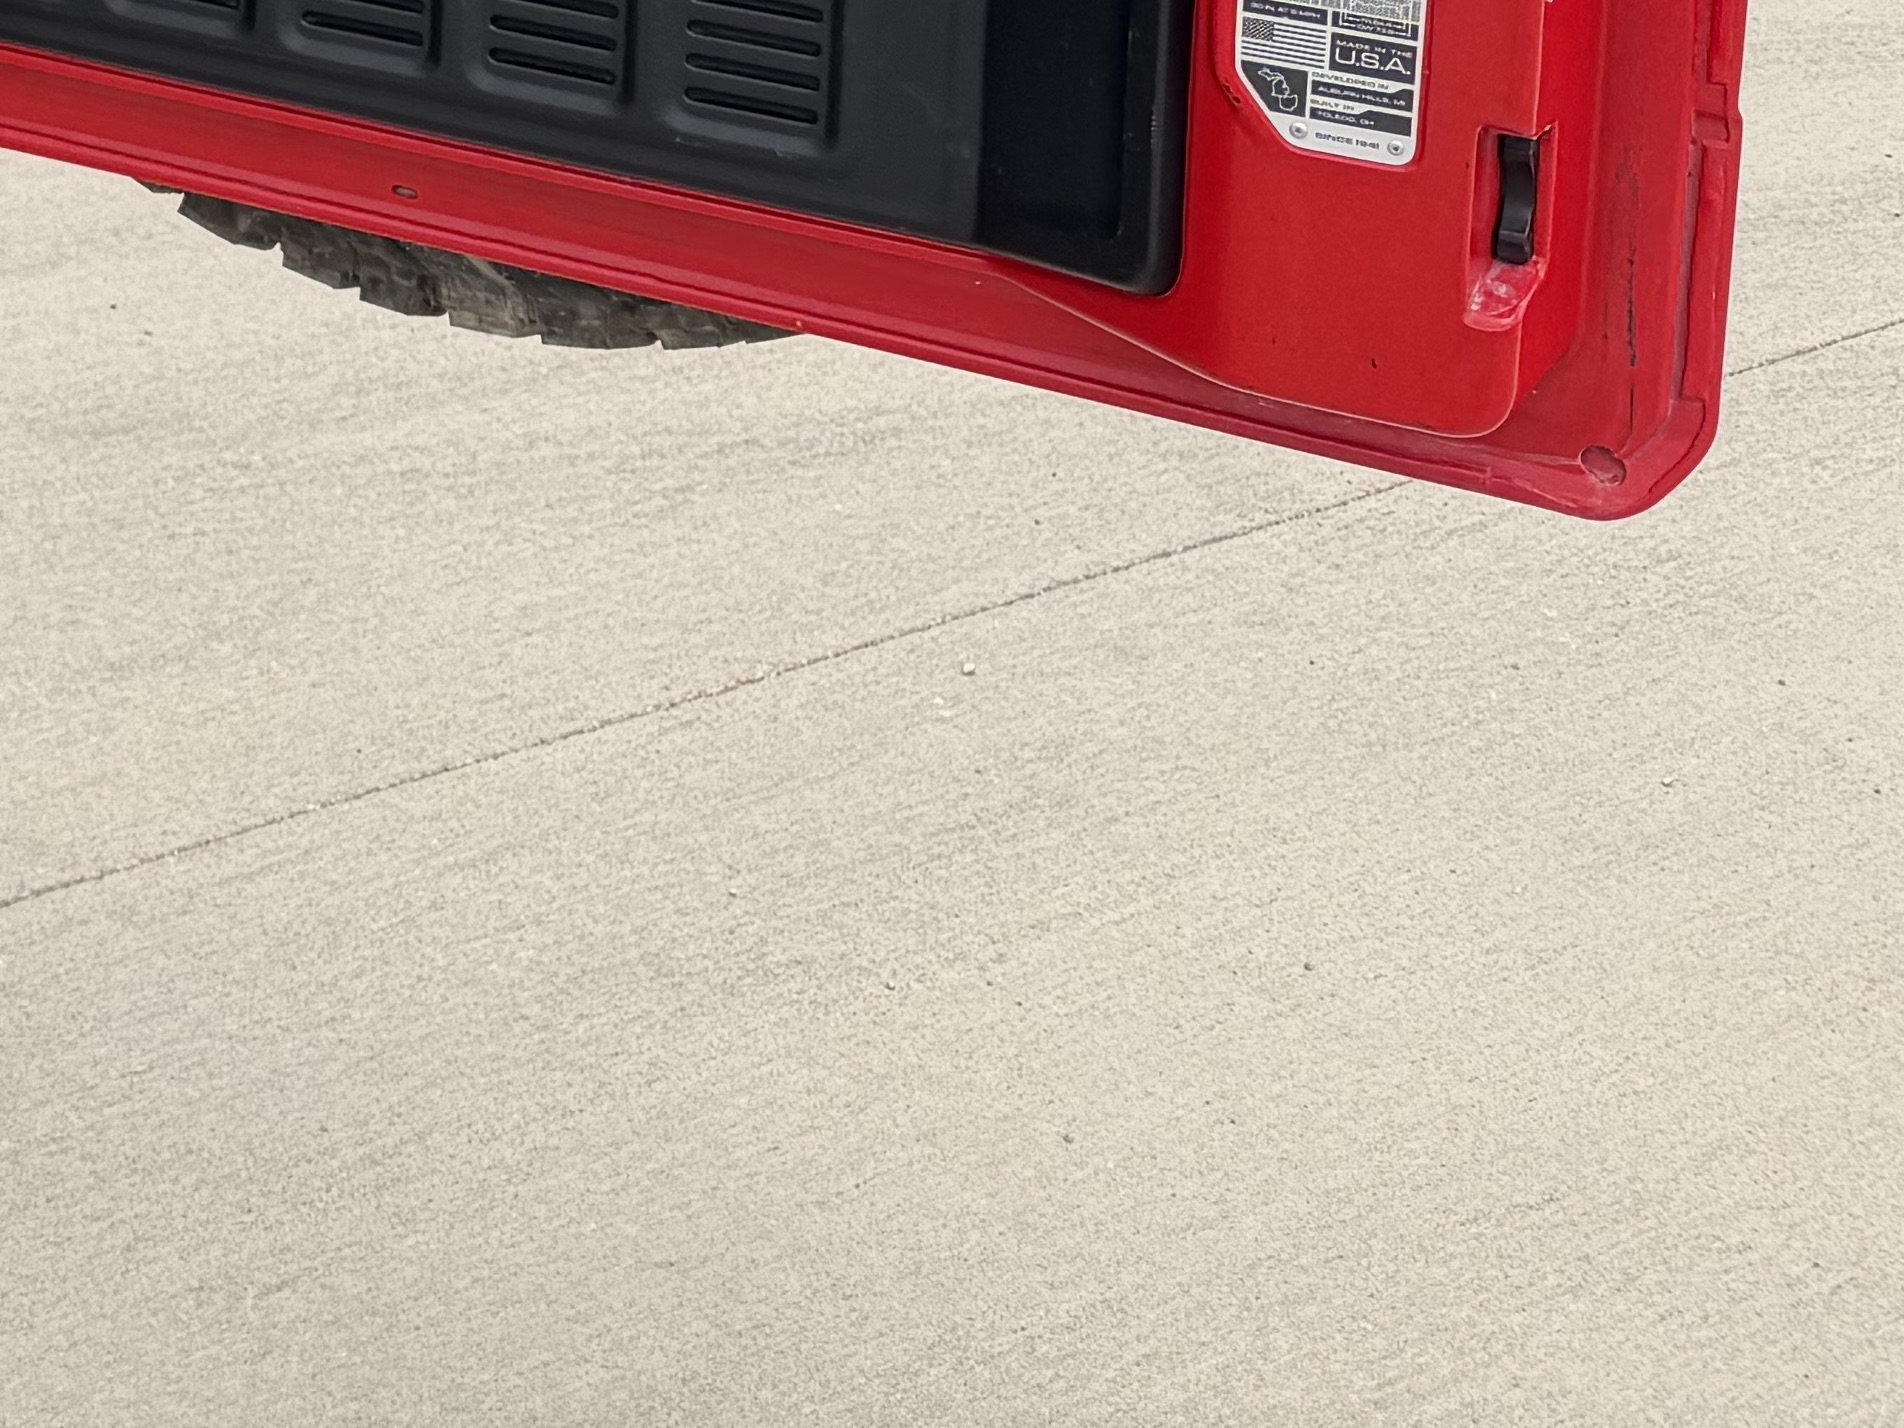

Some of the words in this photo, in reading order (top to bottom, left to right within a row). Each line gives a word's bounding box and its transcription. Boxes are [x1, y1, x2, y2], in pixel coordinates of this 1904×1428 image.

[1336, 39, 1371, 51] MADE
[1391, 49, 1413, 59] THE
[1335, 46, 1412, 76] U.S.A.
[1311, 71, 1376, 89] DEVELOPED
[1314, 131, 1353, 146] SINCE
[1355, 138, 1380, 150] 1941
